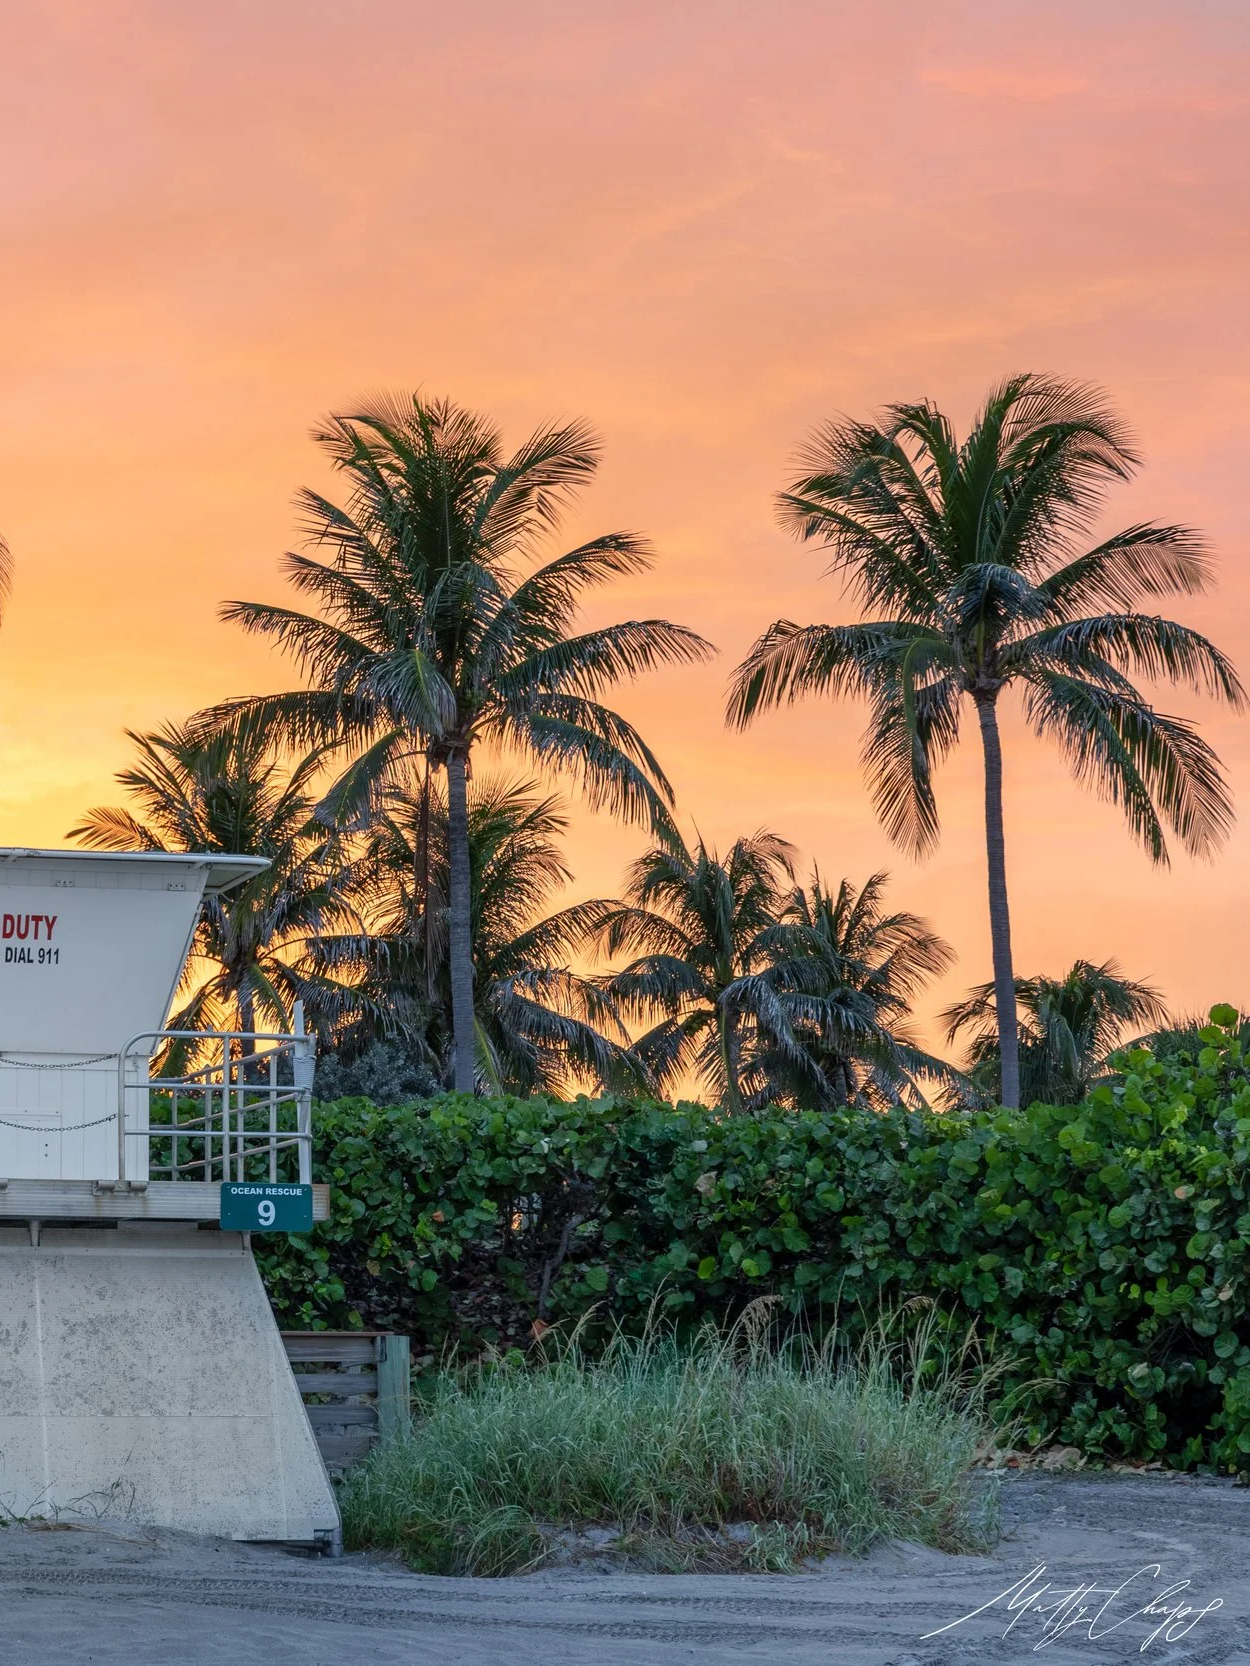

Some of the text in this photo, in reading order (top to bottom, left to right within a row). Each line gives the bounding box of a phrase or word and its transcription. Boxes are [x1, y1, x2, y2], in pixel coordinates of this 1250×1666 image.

[2, 914, 58, 940] DUTY
[5, 947, 34, 963] DIAL
[38, 948, 59, 965] 911
[231, 1187, 302, 1196] OCEAN RESCUE
[257, 1199, 276, 1226] 9
